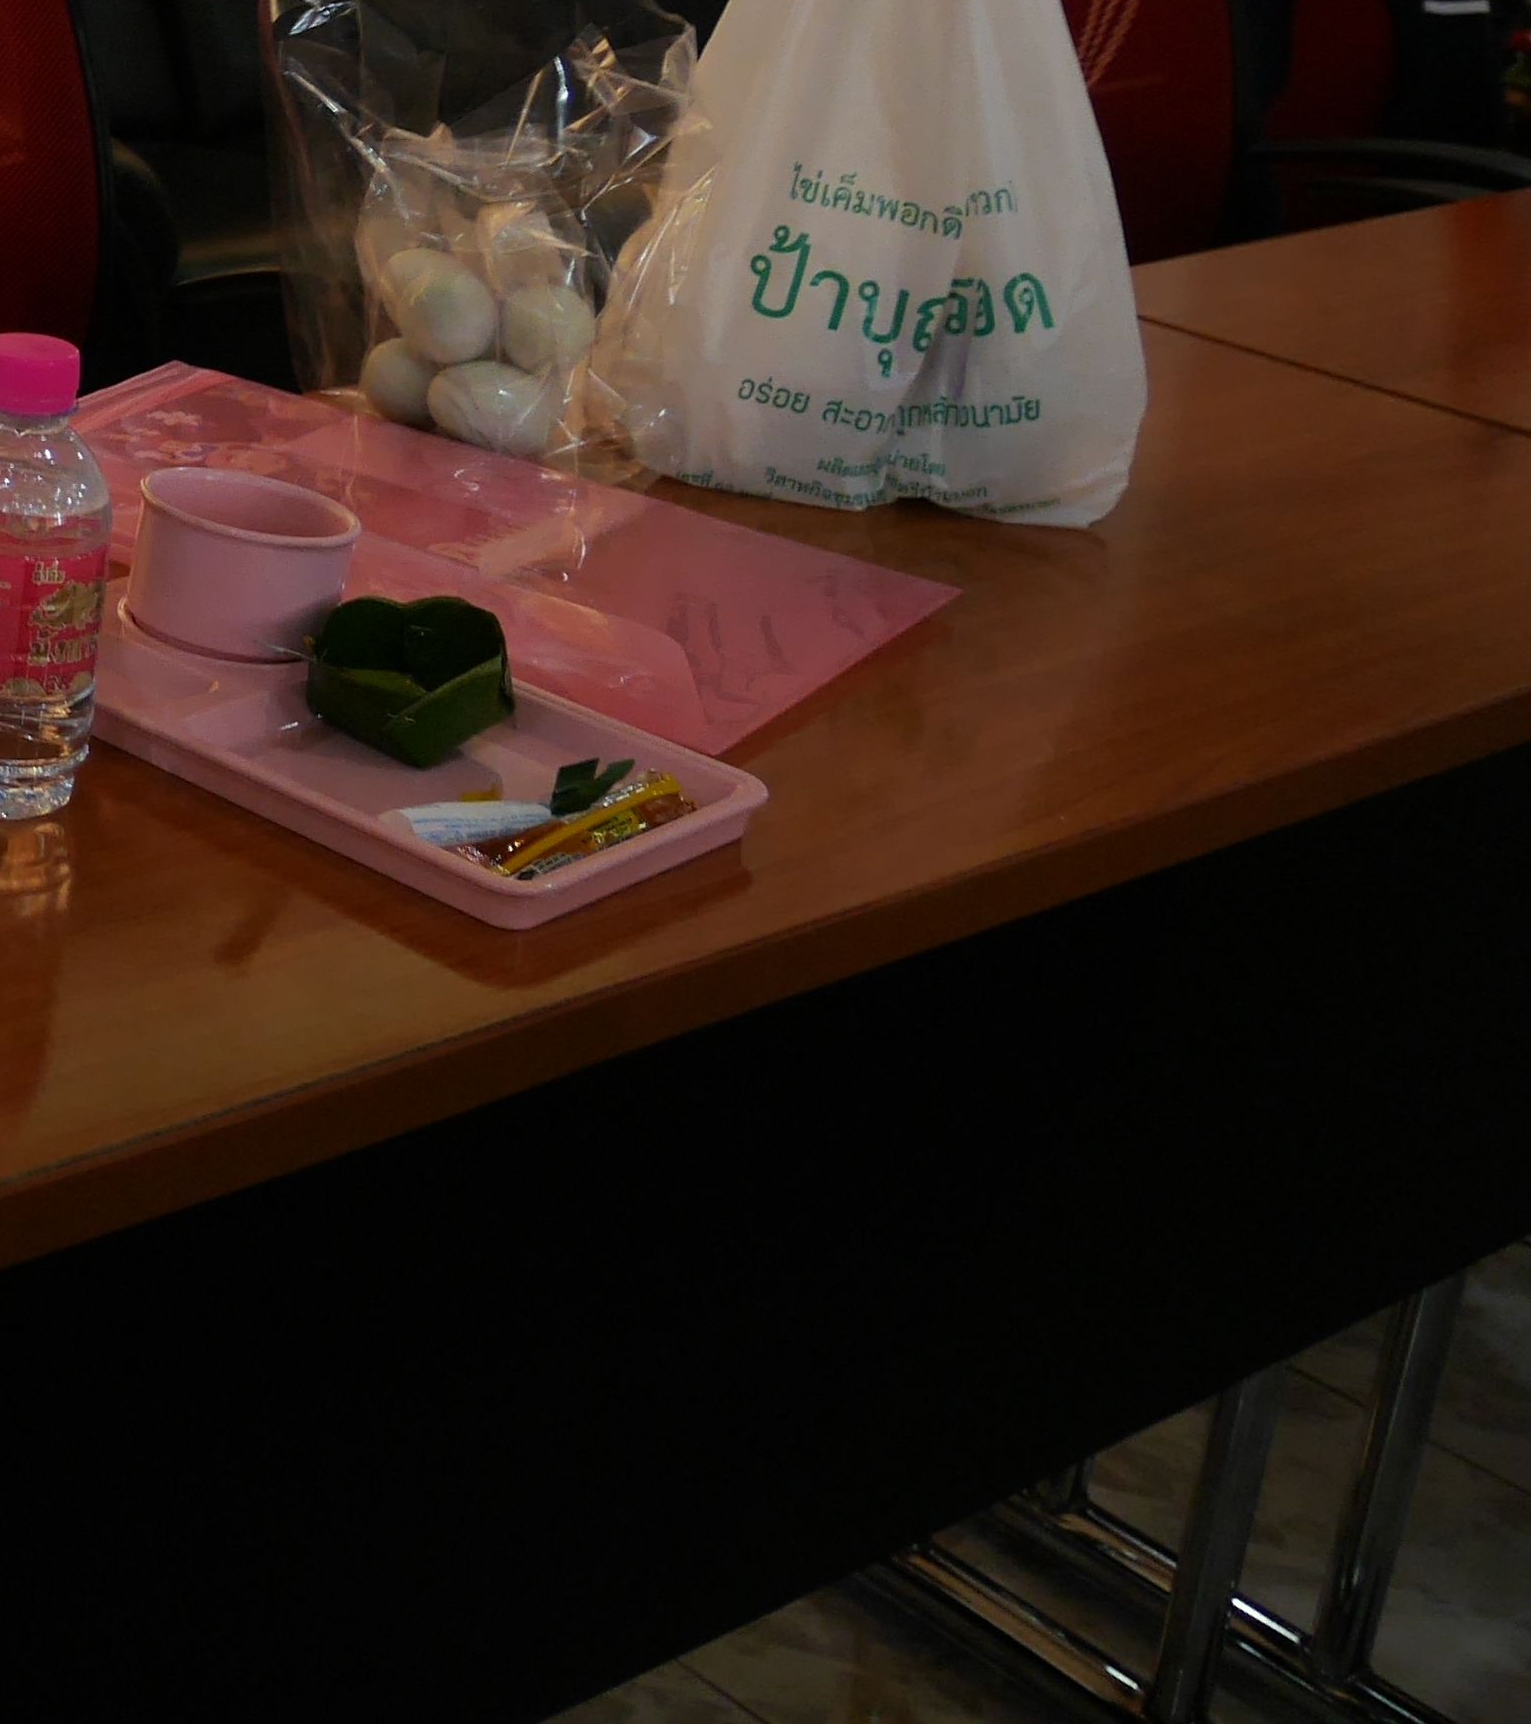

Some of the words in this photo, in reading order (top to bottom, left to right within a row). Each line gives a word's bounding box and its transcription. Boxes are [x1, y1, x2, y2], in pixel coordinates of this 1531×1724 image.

[790, 161, 964, 240] ไข่เค็มพอกดิ
[738, 377, 811, 414] อร่อย
[823, 399, 896, 434] สะอา
